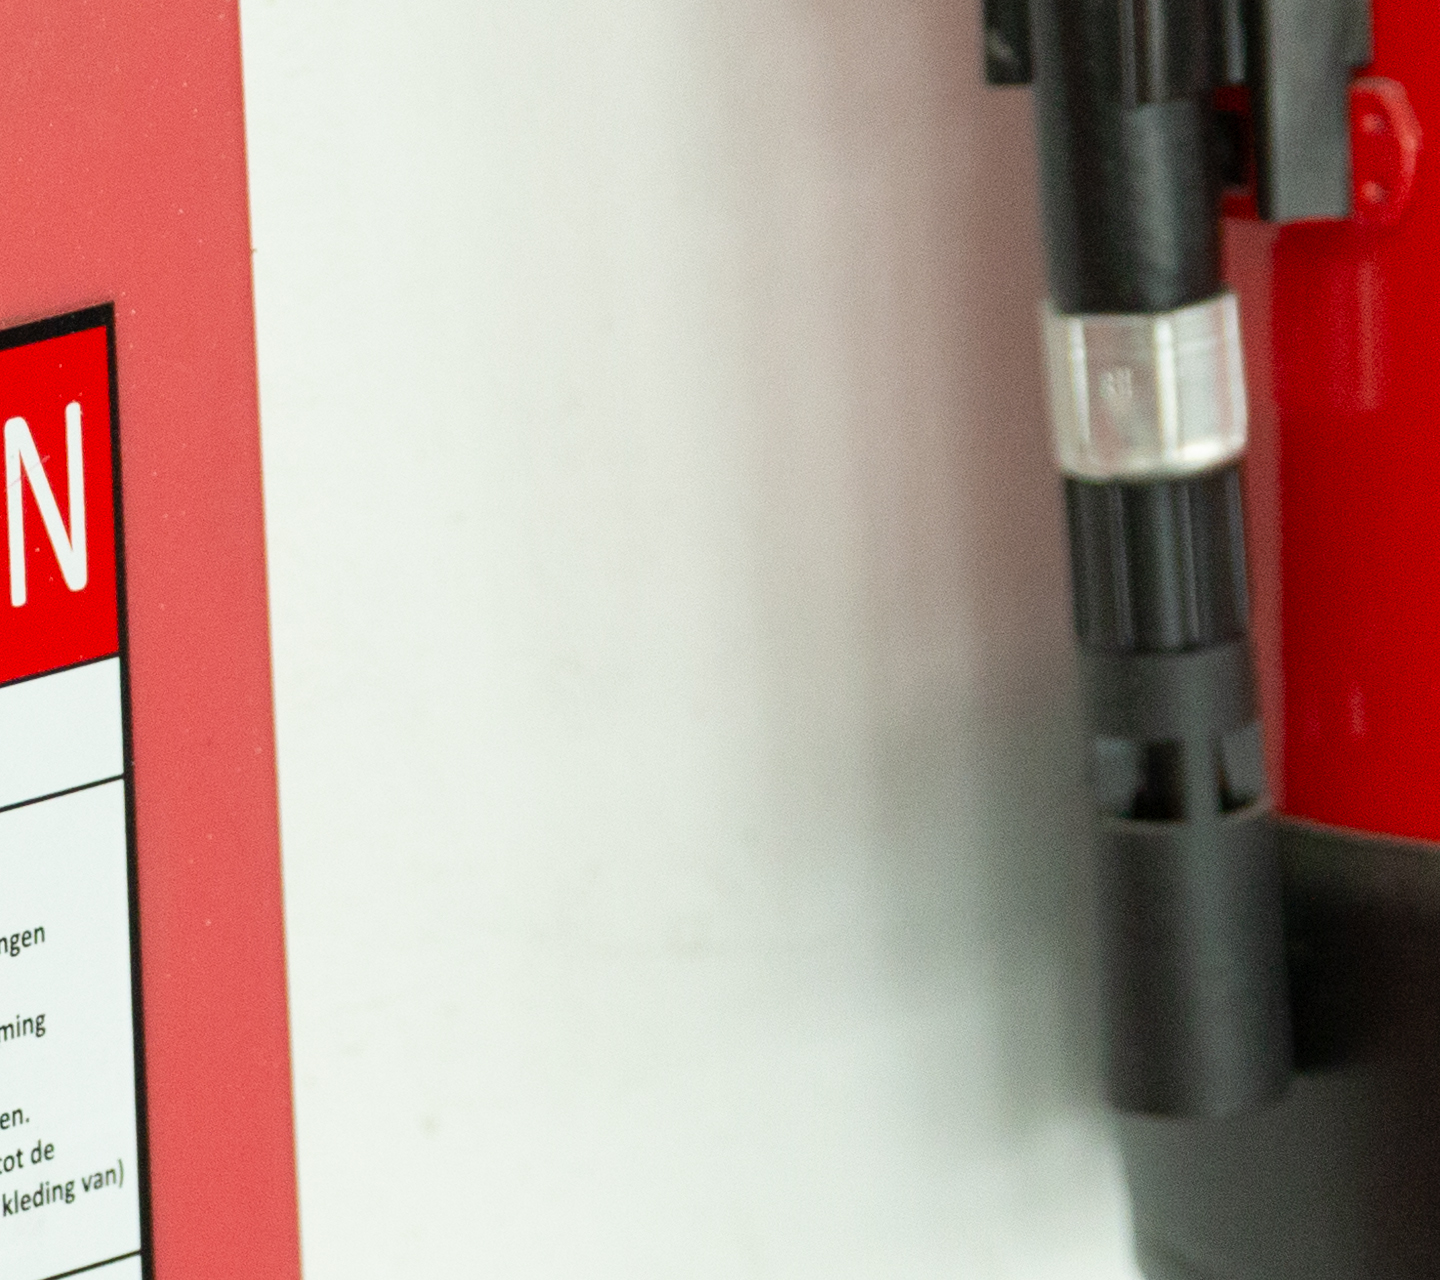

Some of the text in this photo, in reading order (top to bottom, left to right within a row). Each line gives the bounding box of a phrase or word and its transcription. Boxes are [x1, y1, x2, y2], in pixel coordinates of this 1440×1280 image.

[29, 1138, 56, 1166] de
[1, 1179, 76, 1218] kleding
[80, 1158, 125, 1194] van)
